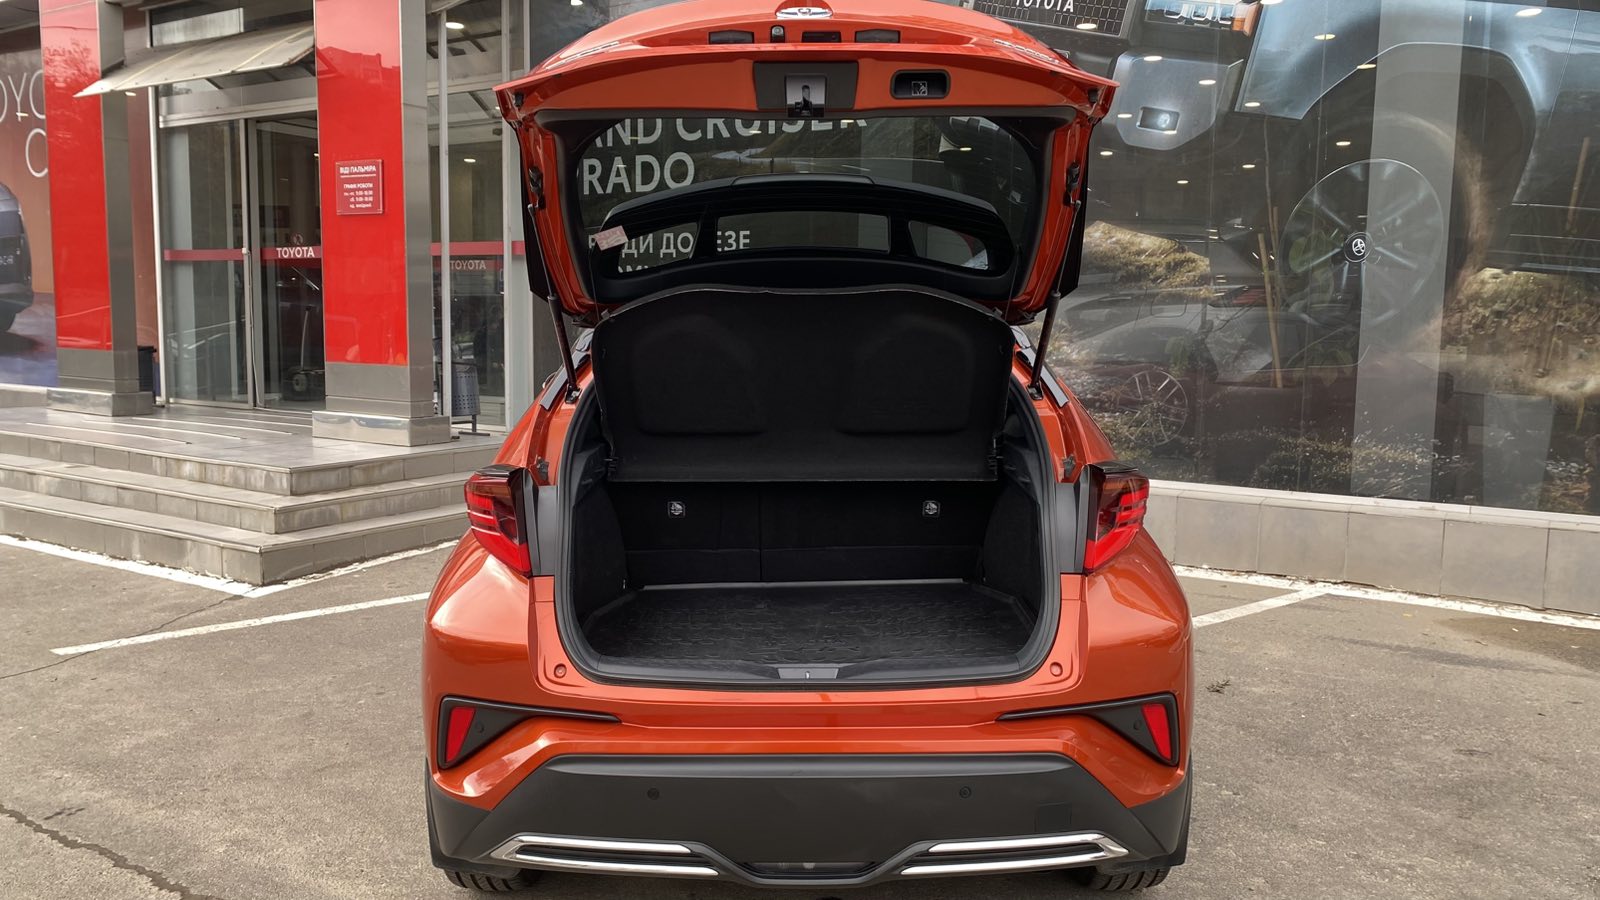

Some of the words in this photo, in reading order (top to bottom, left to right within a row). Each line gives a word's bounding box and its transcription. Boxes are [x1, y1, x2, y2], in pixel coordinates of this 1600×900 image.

[576, 151, 695, 195] RADO
[276, 246, 316, 259] TOYOTA
[450, 260, 487, 270] TOYOTA
